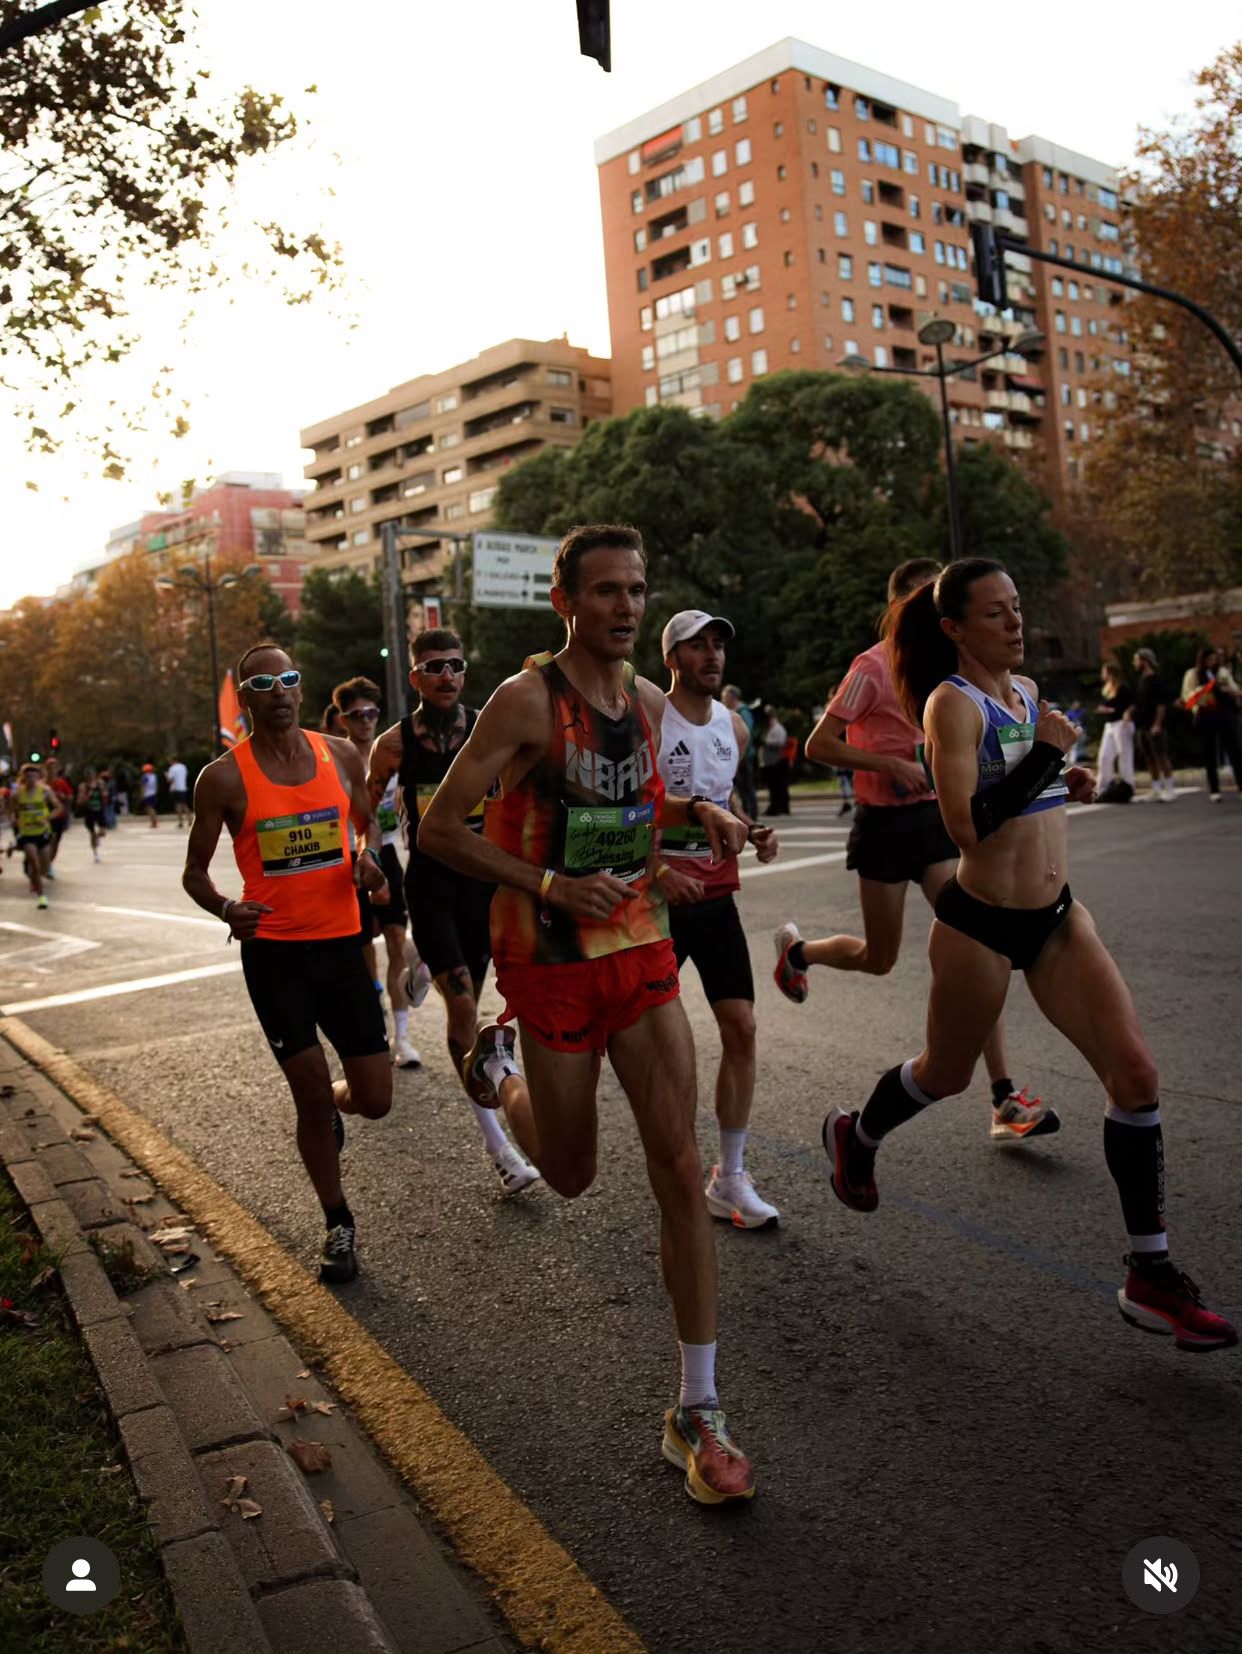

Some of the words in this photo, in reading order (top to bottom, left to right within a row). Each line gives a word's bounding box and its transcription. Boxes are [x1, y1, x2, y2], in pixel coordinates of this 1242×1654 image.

[289, 828, 312, 842] 910
[597, 827, 637, 846] 49260
[284, 842, 320, 856] CHAKIB
